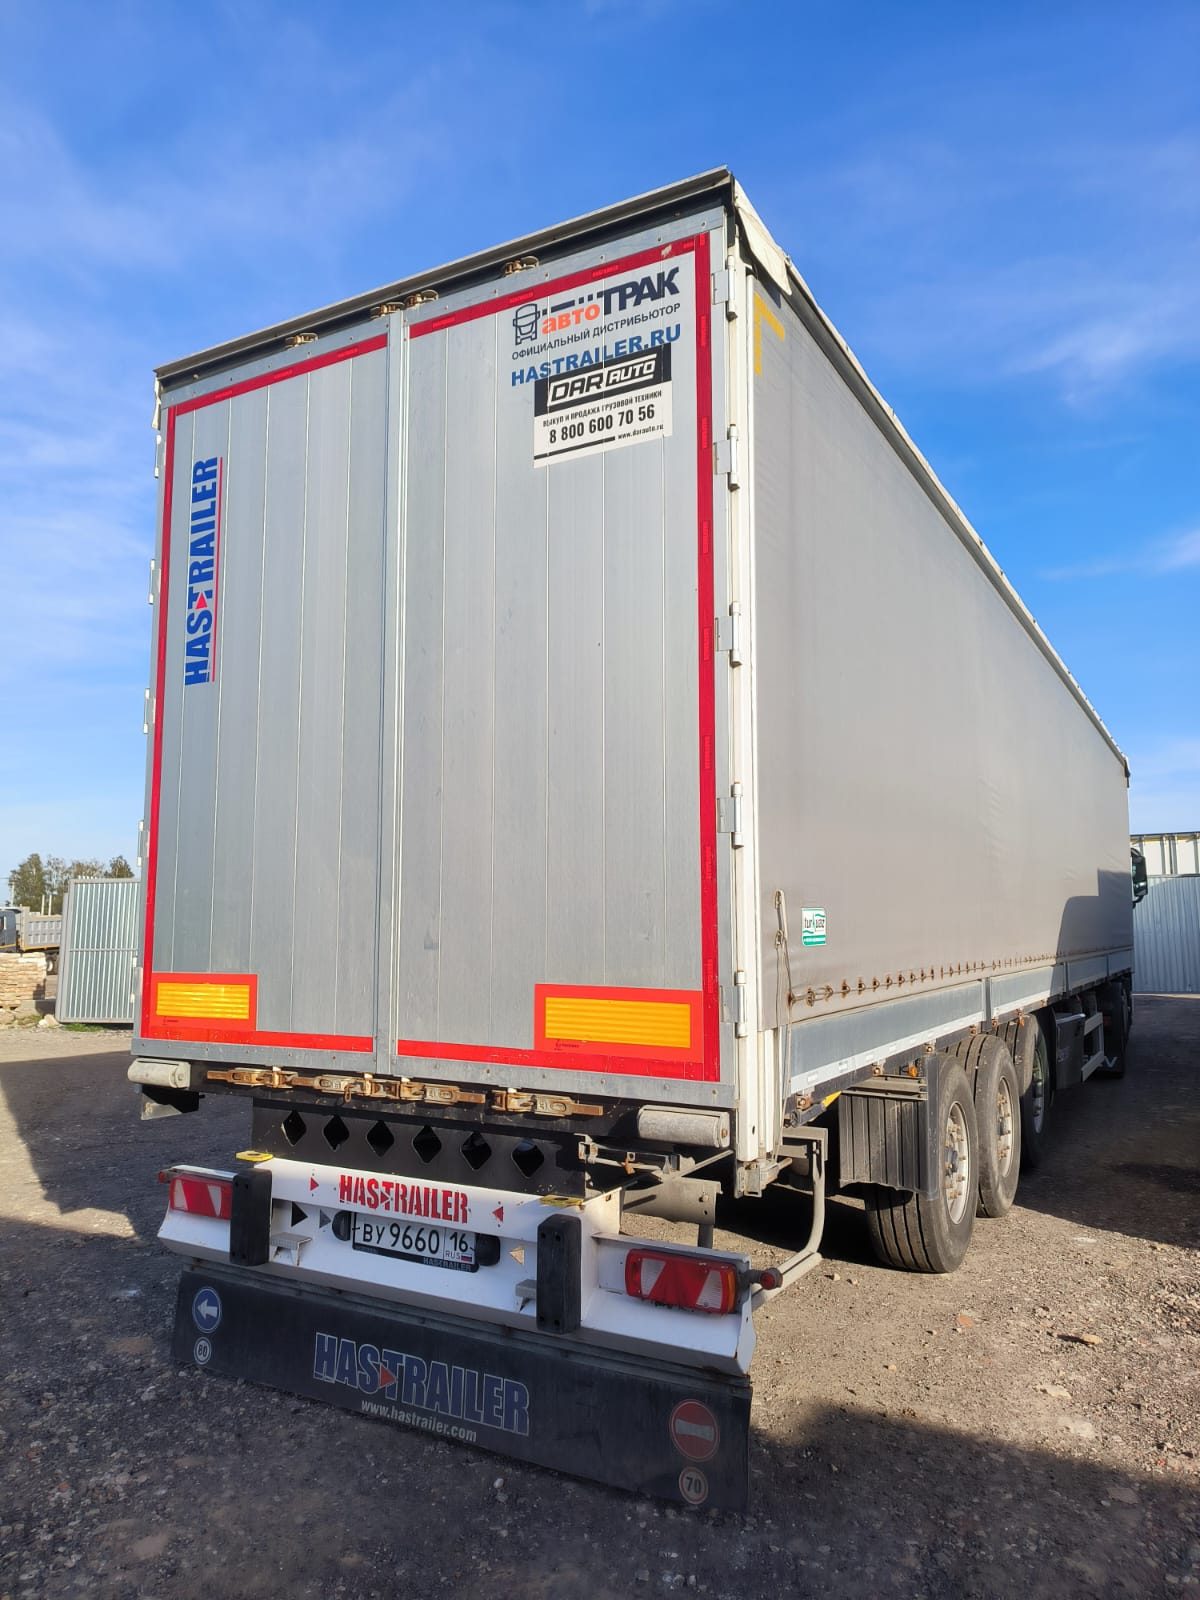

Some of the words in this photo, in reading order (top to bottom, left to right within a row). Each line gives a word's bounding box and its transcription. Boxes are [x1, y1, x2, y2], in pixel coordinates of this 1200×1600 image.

[511, 328, 591, 361] ОФИЦИАЛЬНЫЙ
[592, 302, 681, 337] ДИСТРИБЬЮТОР
[511, 323, 681, 387] HASTRAILER.RU
[549, 428, 557, 444] 8
[561, 422, 585, 441] 800
[589, 414, 613, 434] 600
[617, 409, 634, 427] 70
[638, 403, 655, 422] 56
[570, 406, 601, 420] ПРОДАЖА
[601, 396, 634, 413] ГРУЗОВОЙ
[634, 389, 662, 404] ТЕХНИКИ
[184, 456, 218, 686] HASTRAILER
[339, 1175, 469, 1224] HASTRAILER
[389, 1223, 440, 1255] 9660
[445, 1250, 461, 1261] RUS
[449, 1231, 469, 1253] 16
[313, 1332, 530, 1437] HASTRAILER
[360, 1399, 477, 1444] www.hastrailer.com
[686, 1475, 701, 1494] 70
